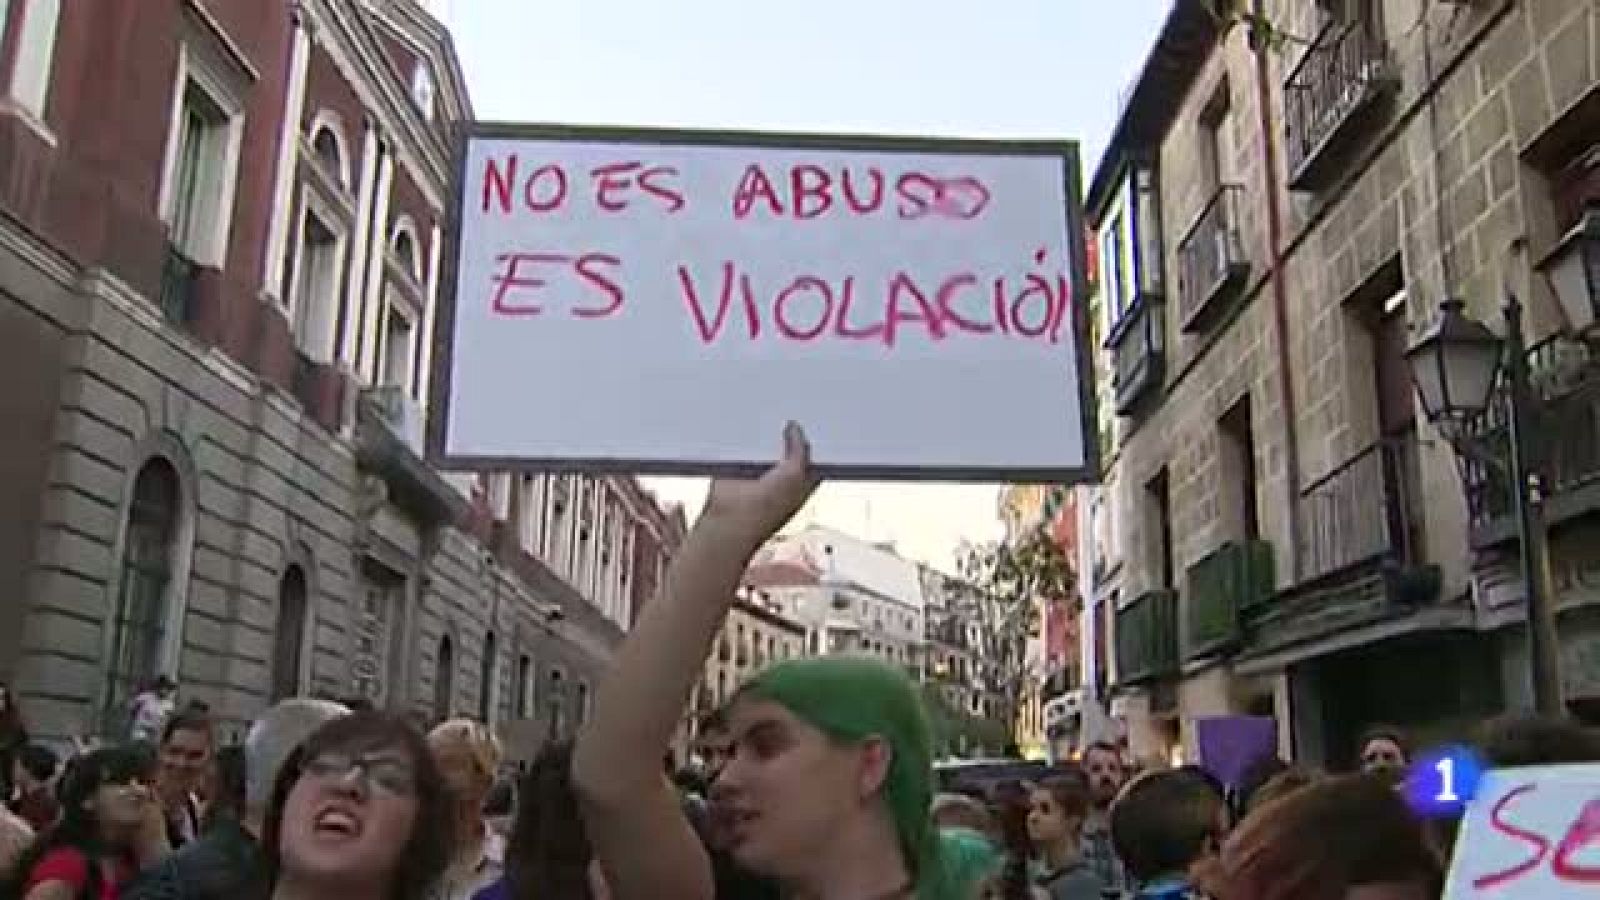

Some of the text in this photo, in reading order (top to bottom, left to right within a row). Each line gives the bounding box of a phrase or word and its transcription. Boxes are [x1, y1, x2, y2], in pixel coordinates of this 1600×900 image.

[482, 153, 991, 220] NO ES ABUSO
[491, 253, 624, 317] ES
